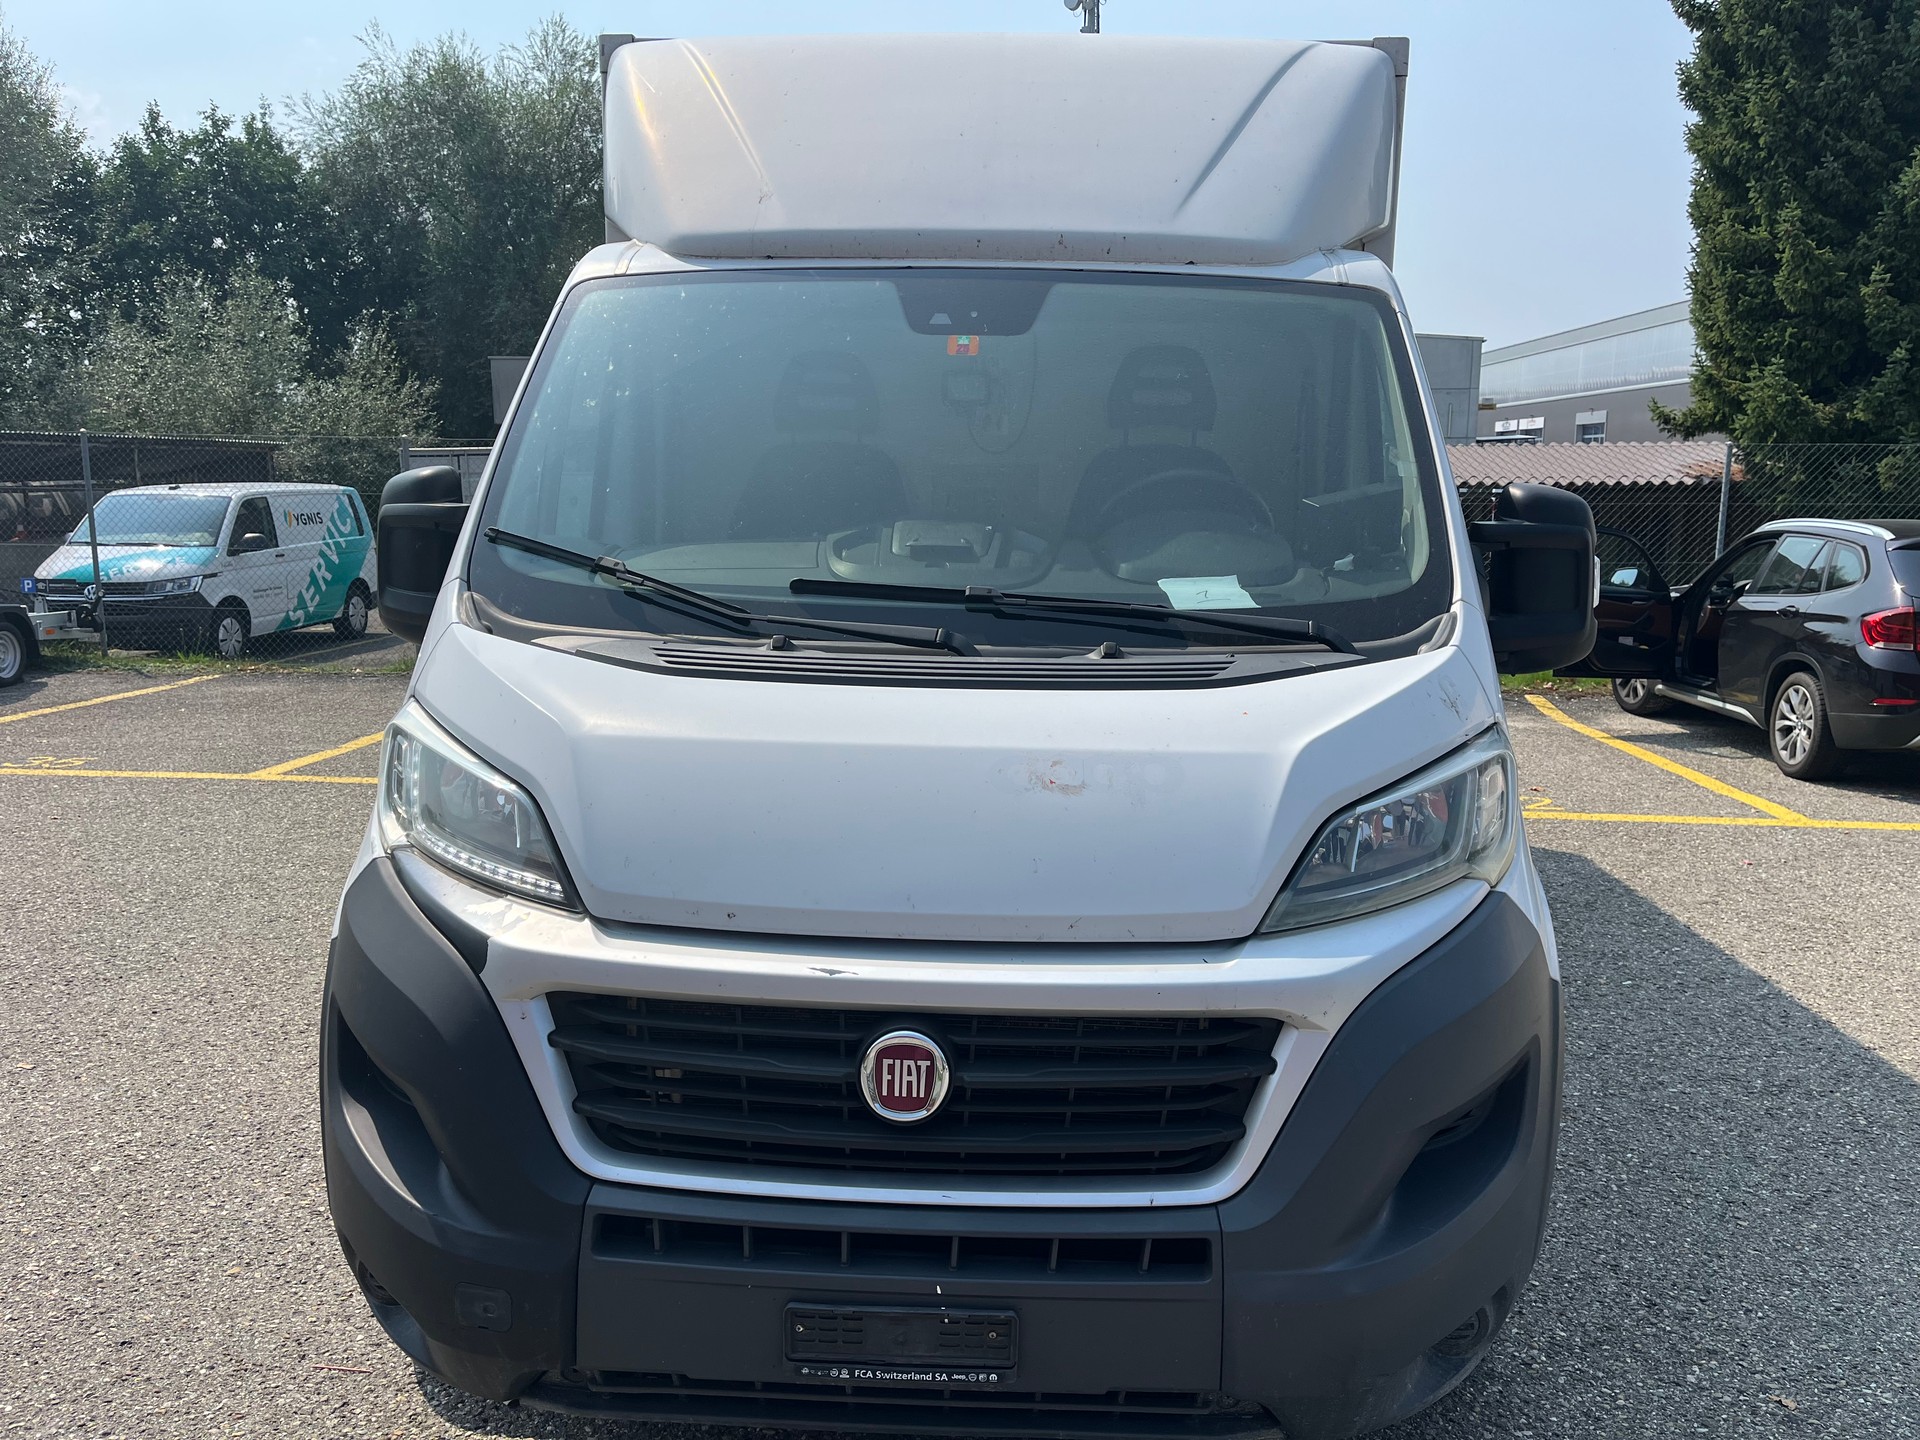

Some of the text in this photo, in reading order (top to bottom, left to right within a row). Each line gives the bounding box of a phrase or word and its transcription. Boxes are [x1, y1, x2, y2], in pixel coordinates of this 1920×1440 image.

[292, 511, 324, 526] YGNIS
[23, 579, 33, 592] P
[881, 1058, 931, 1098] FIAT
[854, 1369, 874, 1379] FCA
[875, 1370, 933, 1381] Switzerland
[934, 1372, 949, 1382] SA
